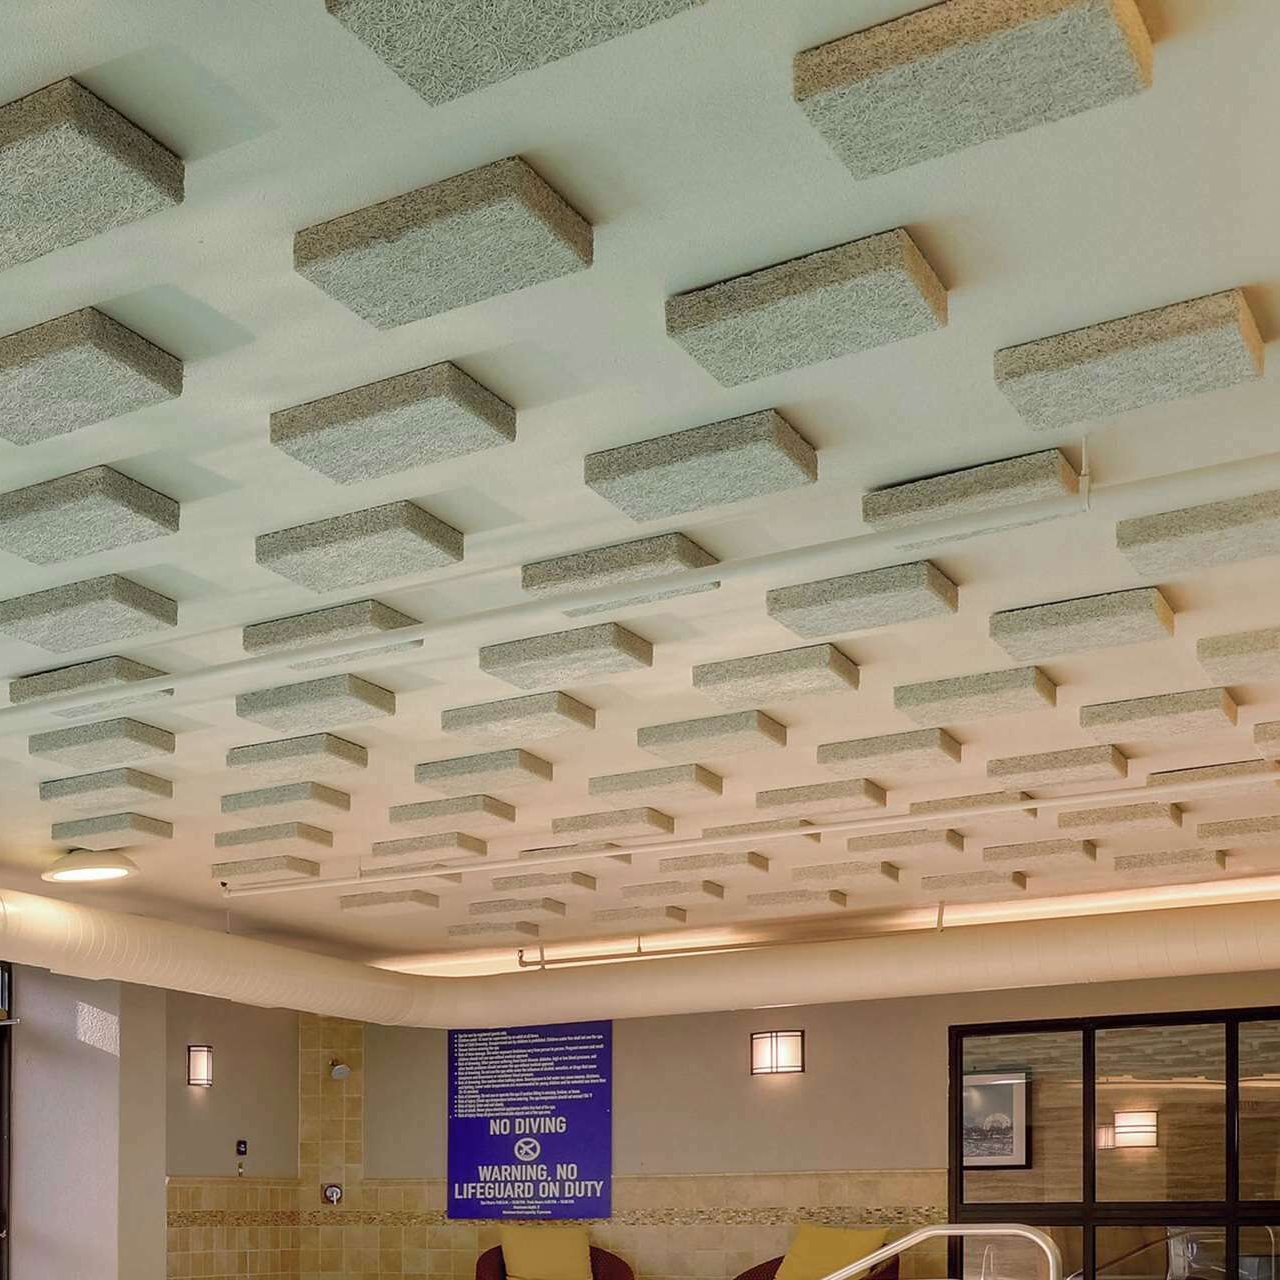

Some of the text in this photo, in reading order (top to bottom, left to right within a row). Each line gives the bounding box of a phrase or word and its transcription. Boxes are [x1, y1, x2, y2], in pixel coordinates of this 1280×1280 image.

[489, 1116, 567, 1135] NO DIVING
[478, 1164, 578, 1182] WARNING, NO
[454, 1181, 604, 1199] LIFEGUARD ON DUTY
